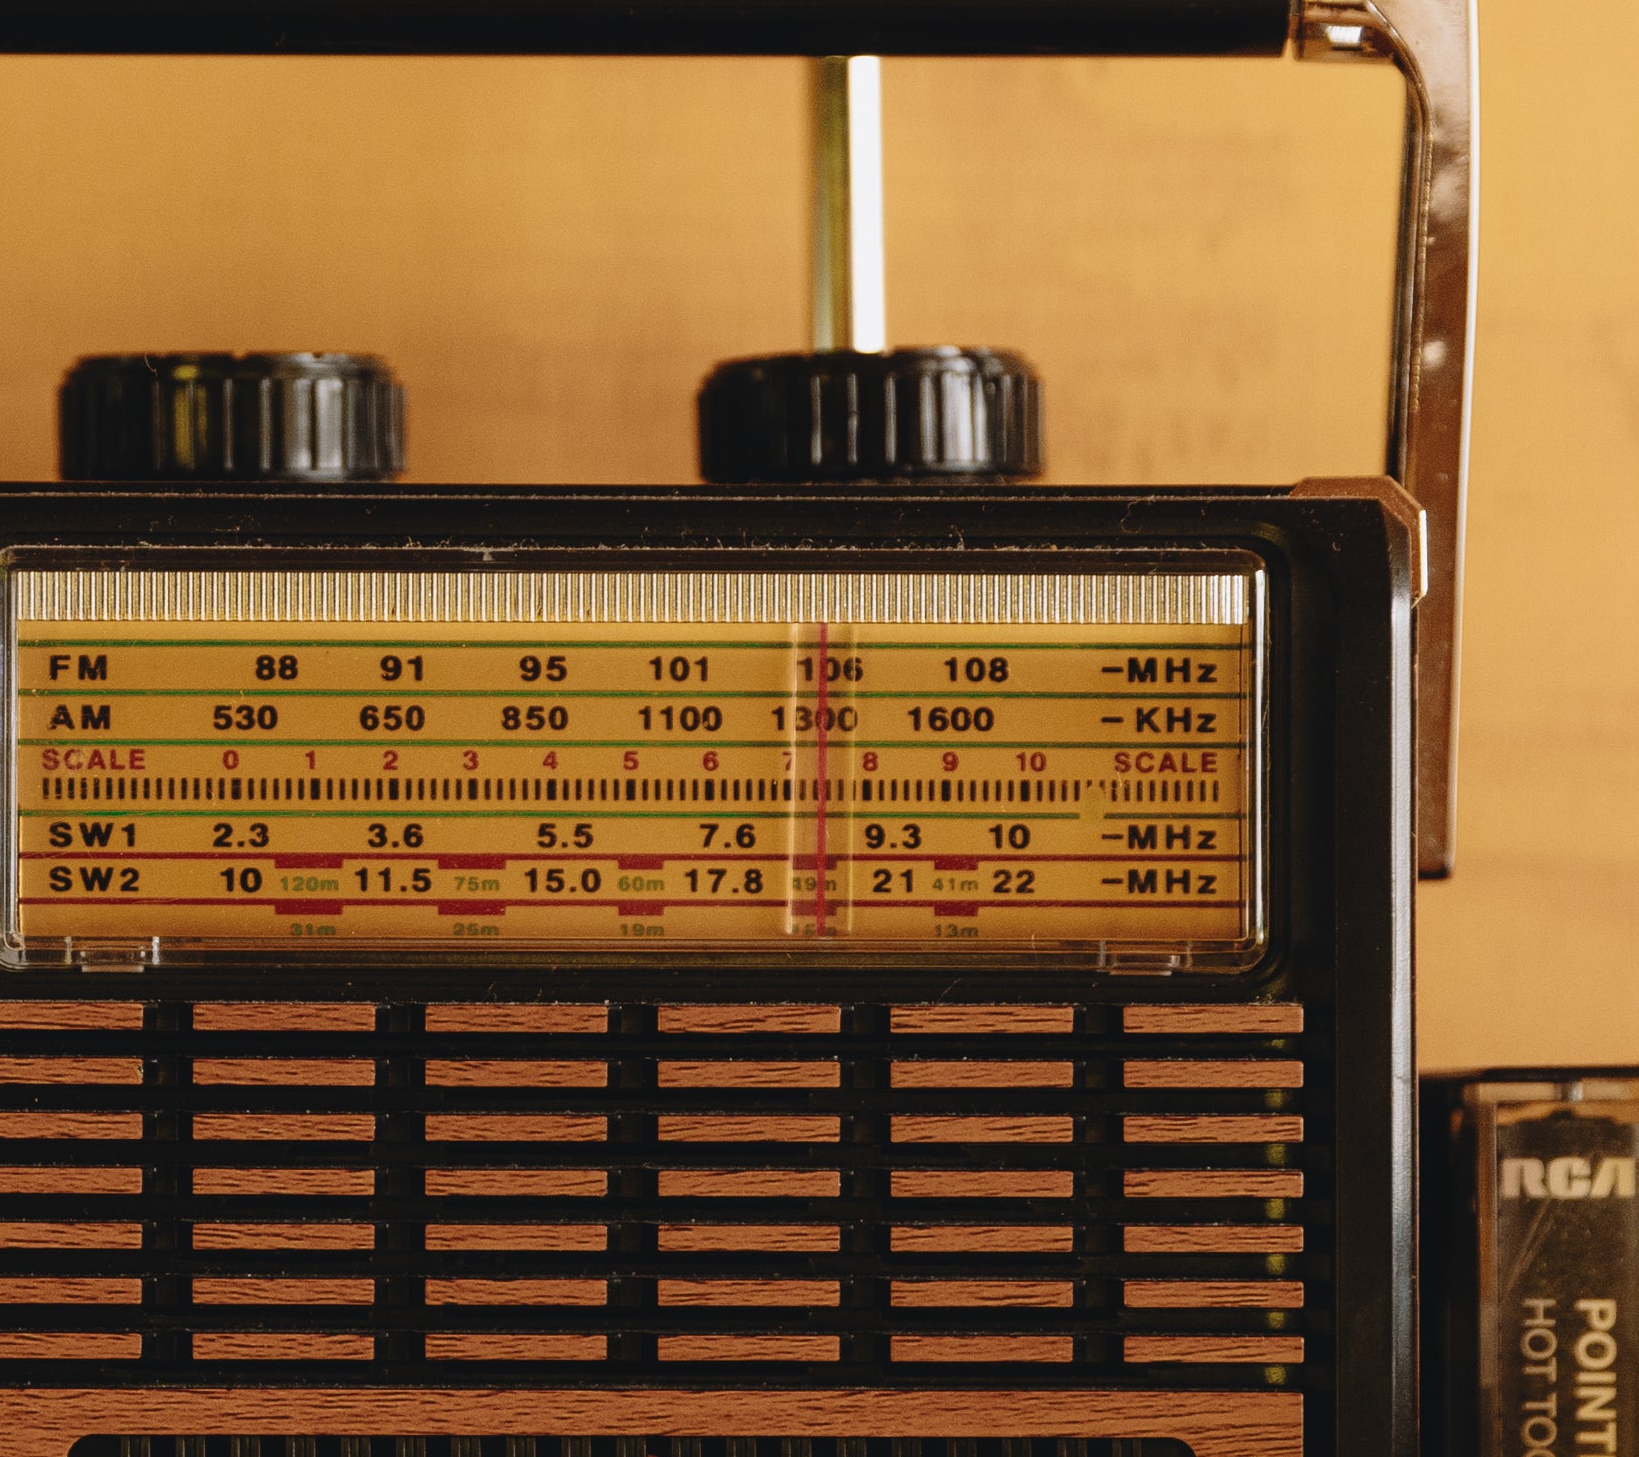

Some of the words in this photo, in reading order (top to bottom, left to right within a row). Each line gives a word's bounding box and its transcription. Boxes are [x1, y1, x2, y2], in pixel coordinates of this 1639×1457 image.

[50, 655, 107, 680] FM
[256, 655, 298, 680] 88
[381, 656, 422, 681] 91
[520, 656, 567, 681] 95
[650, 657, 707, 681] 101
[797, 657, 864, 682] 106
[945, 658, 1008, 683] 108
[50, 705, 110, 729] AM
[214, 705, 277, 730] 530
[360, 706, 424, 731] 650
[502, 706, 568, 730] 850
[639, 706, 722, 731] 1100
[772, 706, 858, 732] 1300
[908, 707, 994, 731] 1600
[43, 749, 145, 770] SCALE
[1114, 753, 1217, 772] SCALE
[50, 822, 135, 848] SW1
[213, 823, 269, 847] 2.3
[368, 824, 423, 848] 3.6
[538, 823, 593, 848] 5.5
[700, 824, 755, 848] 7.6
[865, 824, 921, 849] 9.3
[989, 824, 1030, 849] 10
[50, 866, 139, 892] SW2
[221, 868, 262, 893] 10
[355, 868, 431, 892] 11.5
[525, 868, 601, 892] 15.0
[685, 869, 763, 894] 17.8
[873, 869, 912, 893] 21
[993, 870, 1034, 893] 22
[1503, 1158, 1635, 1198] RCA
[1523, 1299, 1557, 1381] HOT
